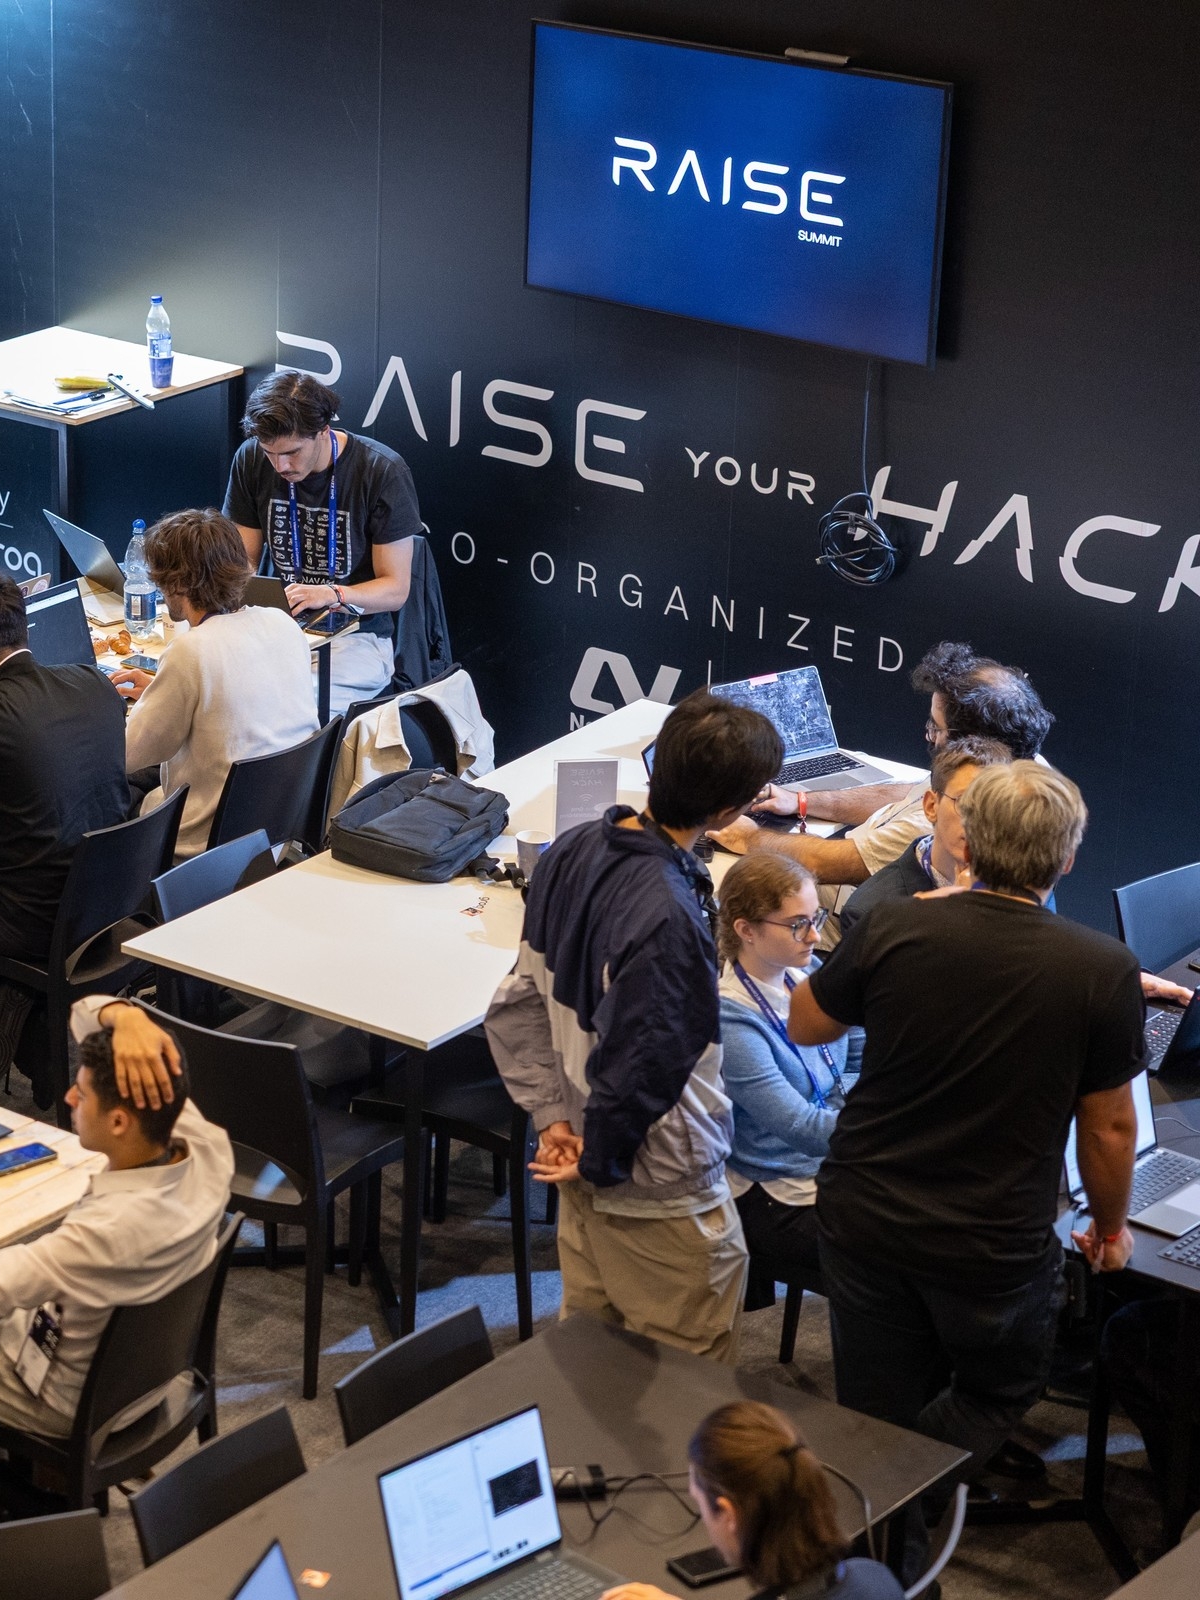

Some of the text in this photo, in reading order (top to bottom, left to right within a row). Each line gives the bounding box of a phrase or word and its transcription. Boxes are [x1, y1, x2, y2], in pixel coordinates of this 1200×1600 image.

[612, 136, 846, 227] RAISE
[798, 230, 842, 247] SUMMIT
[685, 447, 816, 505] YOUR
[415, 521, 903, 673] O-ORGANIZED
